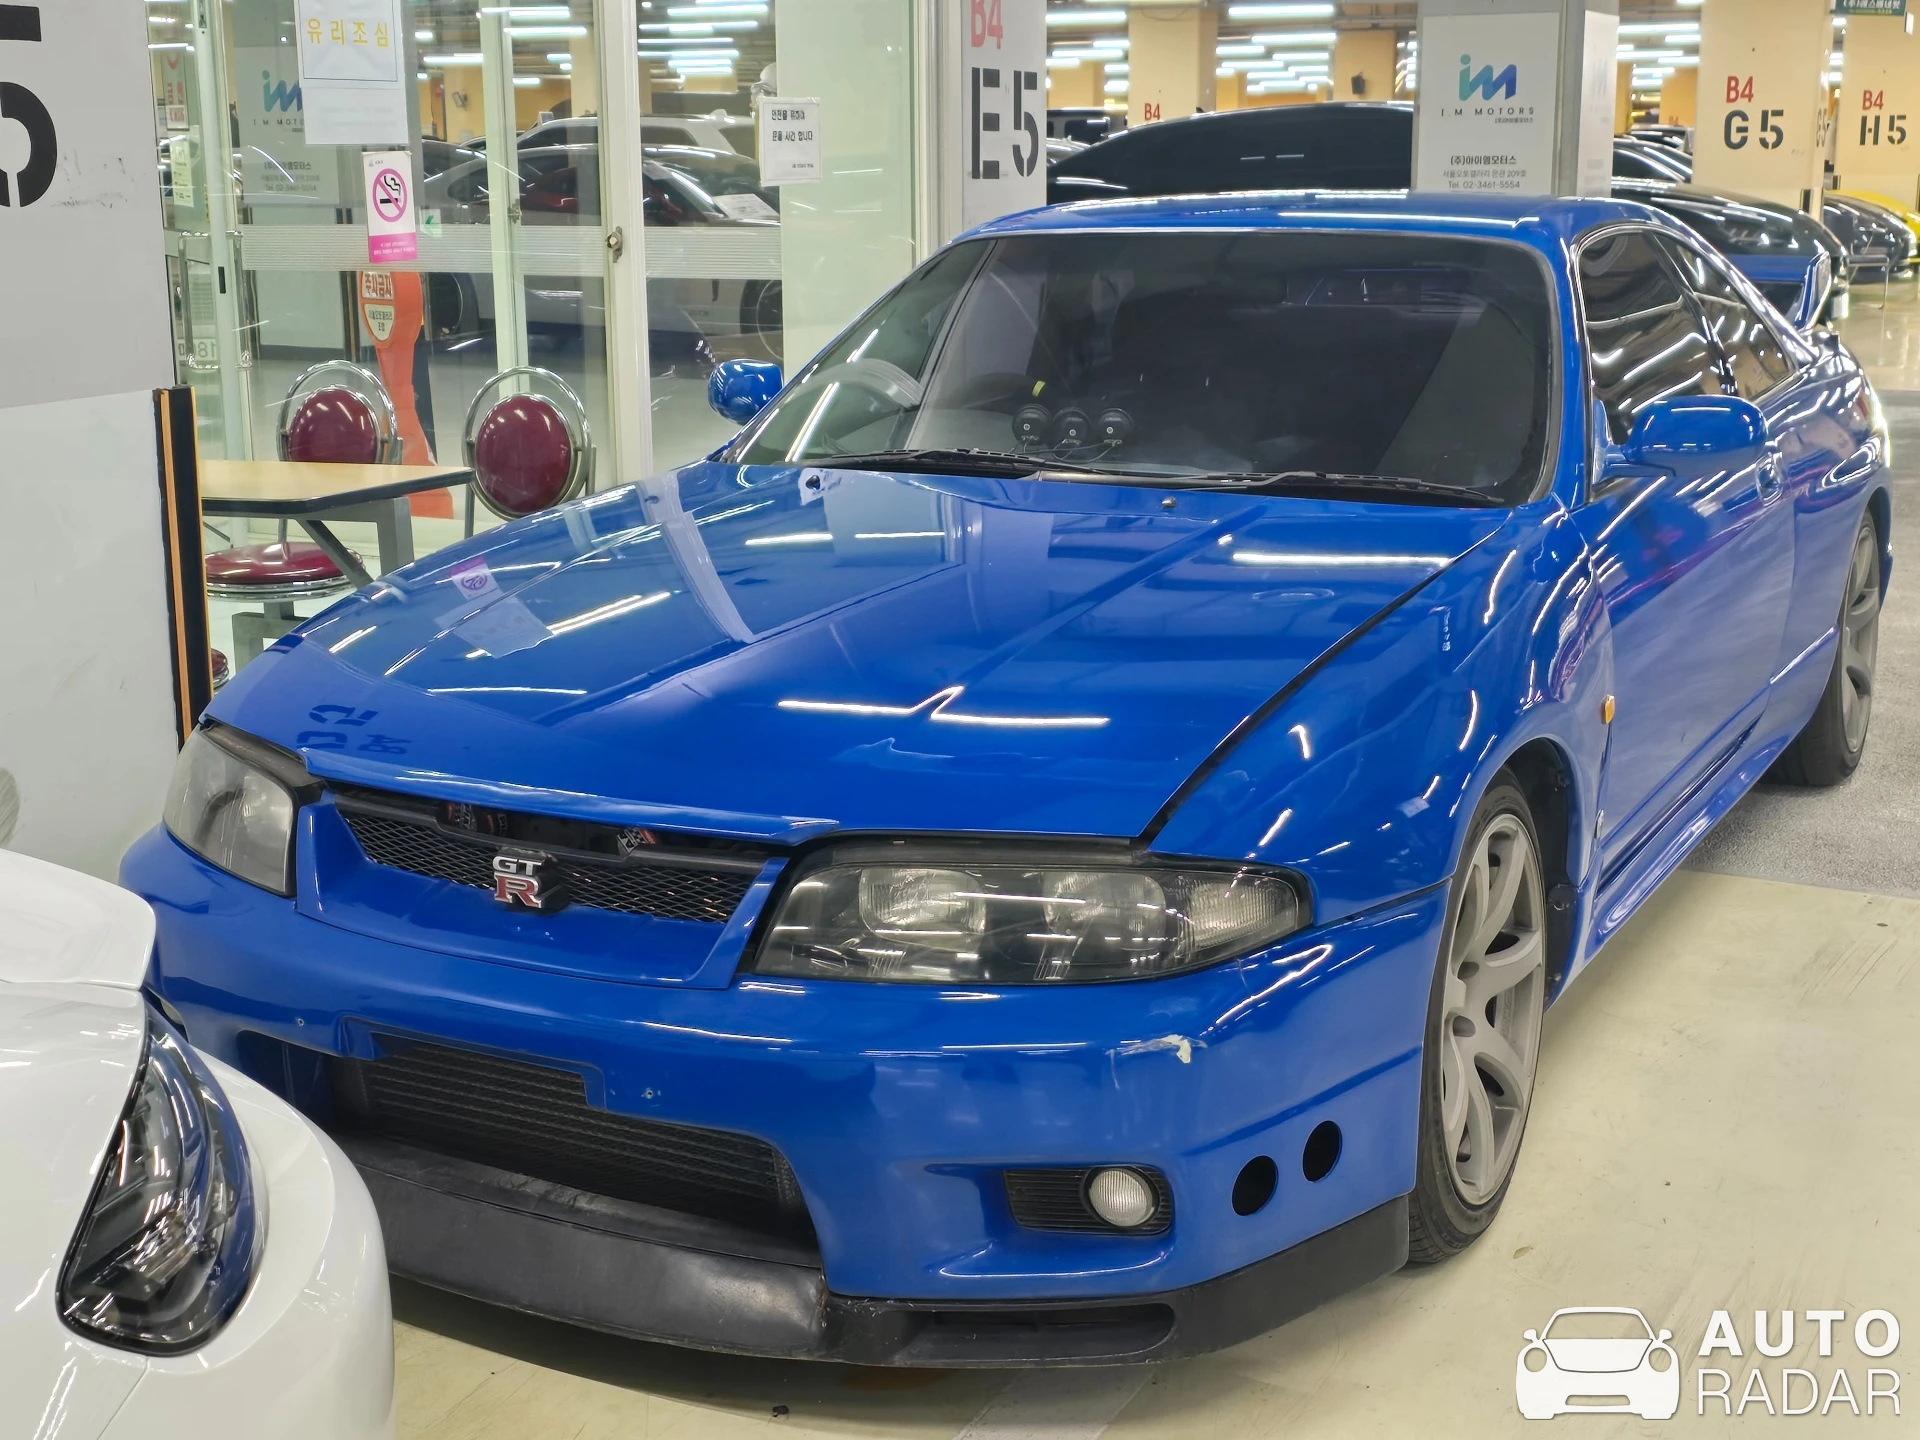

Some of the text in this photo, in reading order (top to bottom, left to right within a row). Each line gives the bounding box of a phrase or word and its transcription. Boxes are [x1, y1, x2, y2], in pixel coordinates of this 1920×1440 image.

[307, 18, 389, 47] 유리조심
[970, 0, 1004, 50] B4
[1726, 75, 1754, 103] B4
[1862, 90, 1884, 110] B4
[1144, 102, 1161, 121] B4
[1474, 107, 1535, 116] MOTORS
[1450, 155, 1517, 166] (주)아이엠모터스
[492, 855, 545, 876] GT
[493, 872, 542, 909] R
